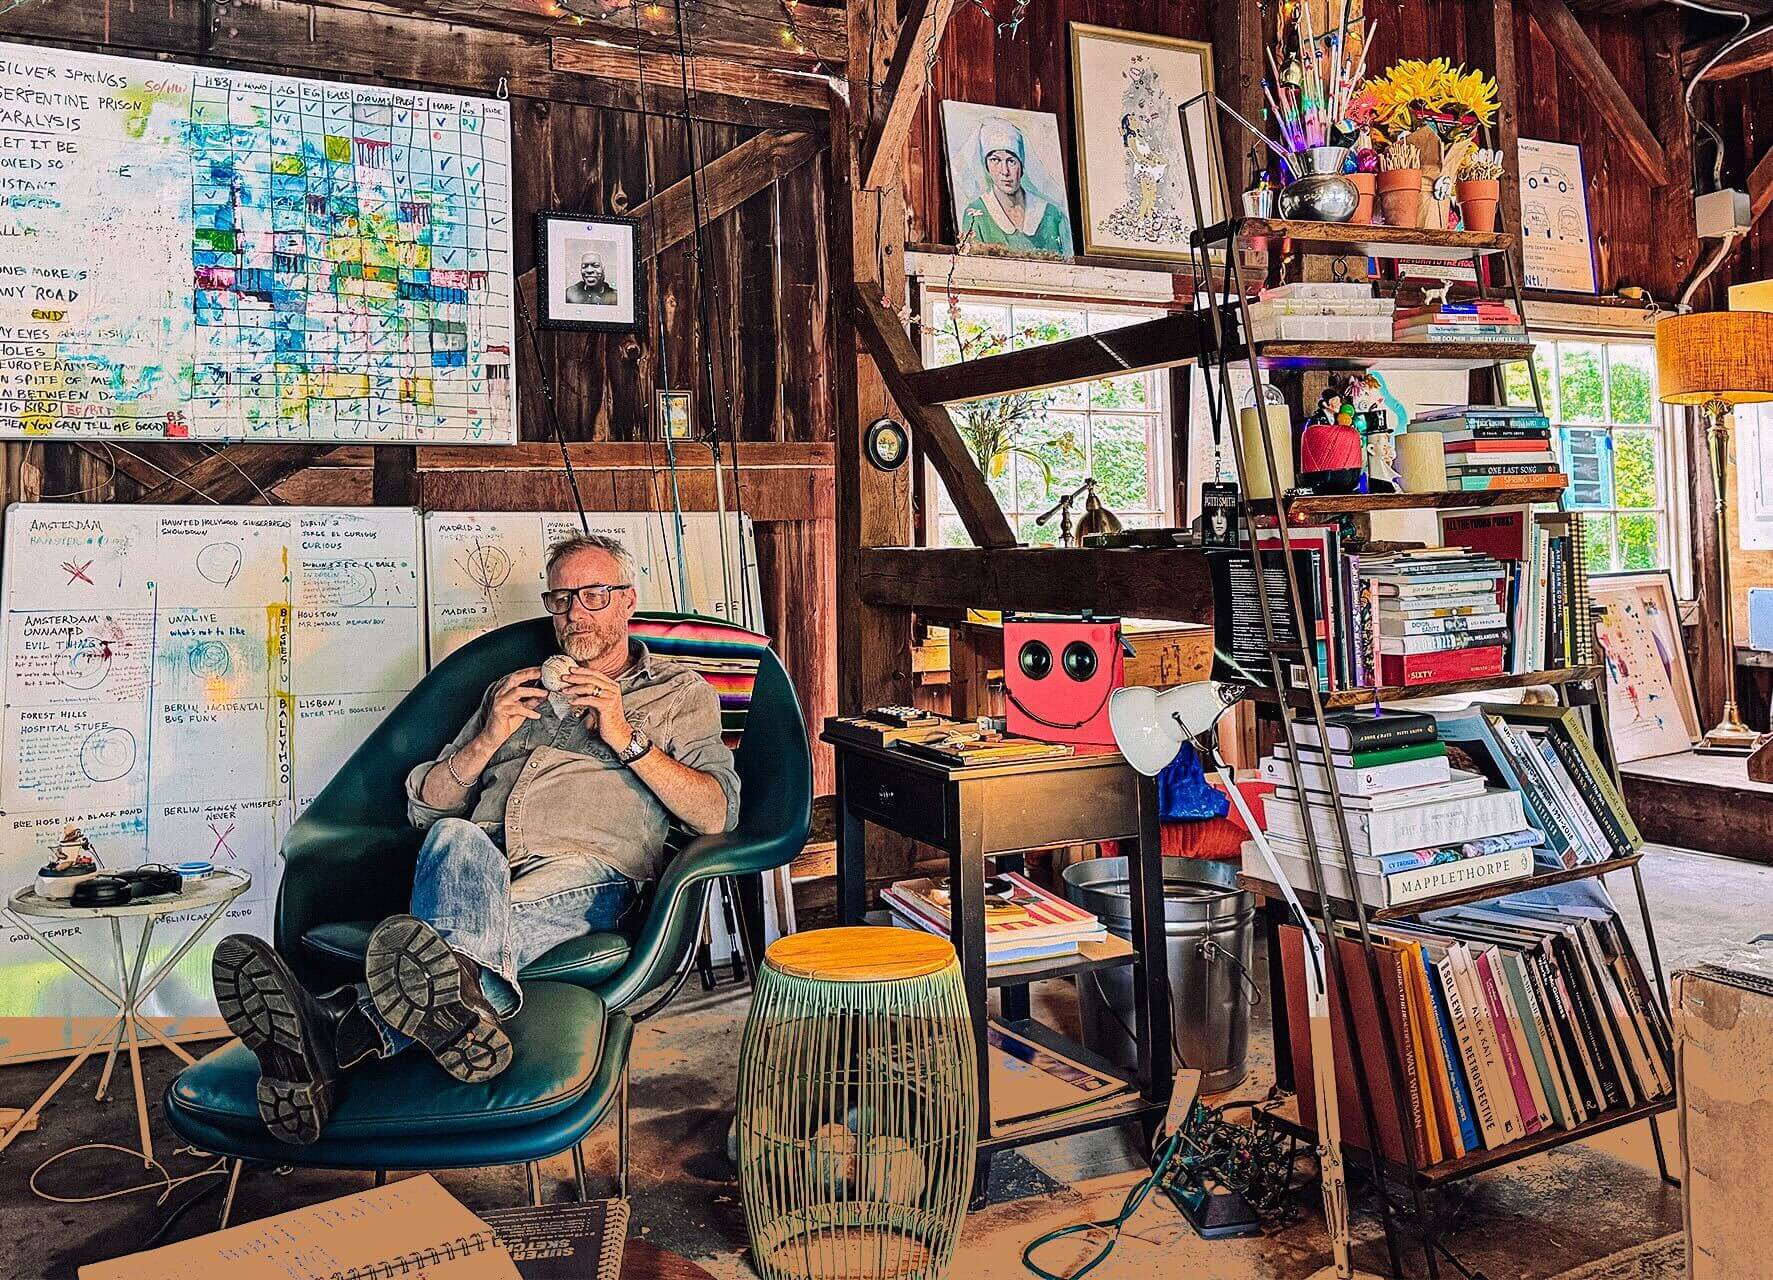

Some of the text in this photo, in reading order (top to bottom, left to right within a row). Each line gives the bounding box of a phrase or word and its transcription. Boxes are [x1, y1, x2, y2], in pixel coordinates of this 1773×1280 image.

[0, 60, 56, 79] SILVER
[65, 69, 128, 89] SPRINGS
[303, 87, 321, 98] EG
[99, 97, 142, 111] PRISON
[31, 138, 78, 154] IT BE
[48, 159, 64, 169] SO
[31, 268, 70, 278] MORE
[1525, 274, 1543, 287] Ntl.
[35, 288, 79, 301] ROAD
[17, 328, 50, 340] EYES
[15, 374, 58, 385] SPITE
[17, 390, 89, 400] BETWEEN
[30, 419, 130, 431] YOU CAN TELL ME
[1503, 466, 1519, 474] LAST
[29, 519, 103, 532] AMSTERDAM
[161, 519, 199, 527] HAUNTED
[439, 524, 472, 532] MADRID
[161, 528, 208, 536] SHOWDOWN
[441, 607, 476, 616] MADRID
[24, 615, 98, 625] AMSTERDAM
[170, 627, 195, 637] what's
[229, 627, 246, 635] like
[25, 640, 50, 650] EVIL
[1411, 671, 1433, 679] SIXTY
[164, 704, 199, 714] BERLIN
[299, 700, 335, 708] LISBON
[21, 712, 55, 720] FOREST
[165, 714, 217, 723] BUS FUNK
[21, 721, 109, 735] HOSPITAL STUFF
[1566, 716, 1581, 735] JOHN
[279, 699, 290, 784] BALLYHOO
[164, 800, 282, 816] BERLIN WHISPERS
[36, 818, 60, 826] HOSE
[88, 811, 117, 820] BLACK
[120, 808, 143, 816] POND
[206, 812, 236, 820] NEVER
[1401, 860, 1510, 894] MAPPLETHORPE
[226, 909, 252, 918] CRUDO
[41, 927, 82, 939] TEMPER
[1441, 970, 1456, 992] SOL
[1448, 994, 1468, 1032] LEWITT
[1439, 1038, 1454, 1071] Computer
[1405, 1050, 1415, 1076] WALT
[1460, 1046, 1497, 1130] RETROSPECTIVE
[1407, 1077, 1423, 1128] WHITMAN
[513, 1248, 575, 1261] SUPER
